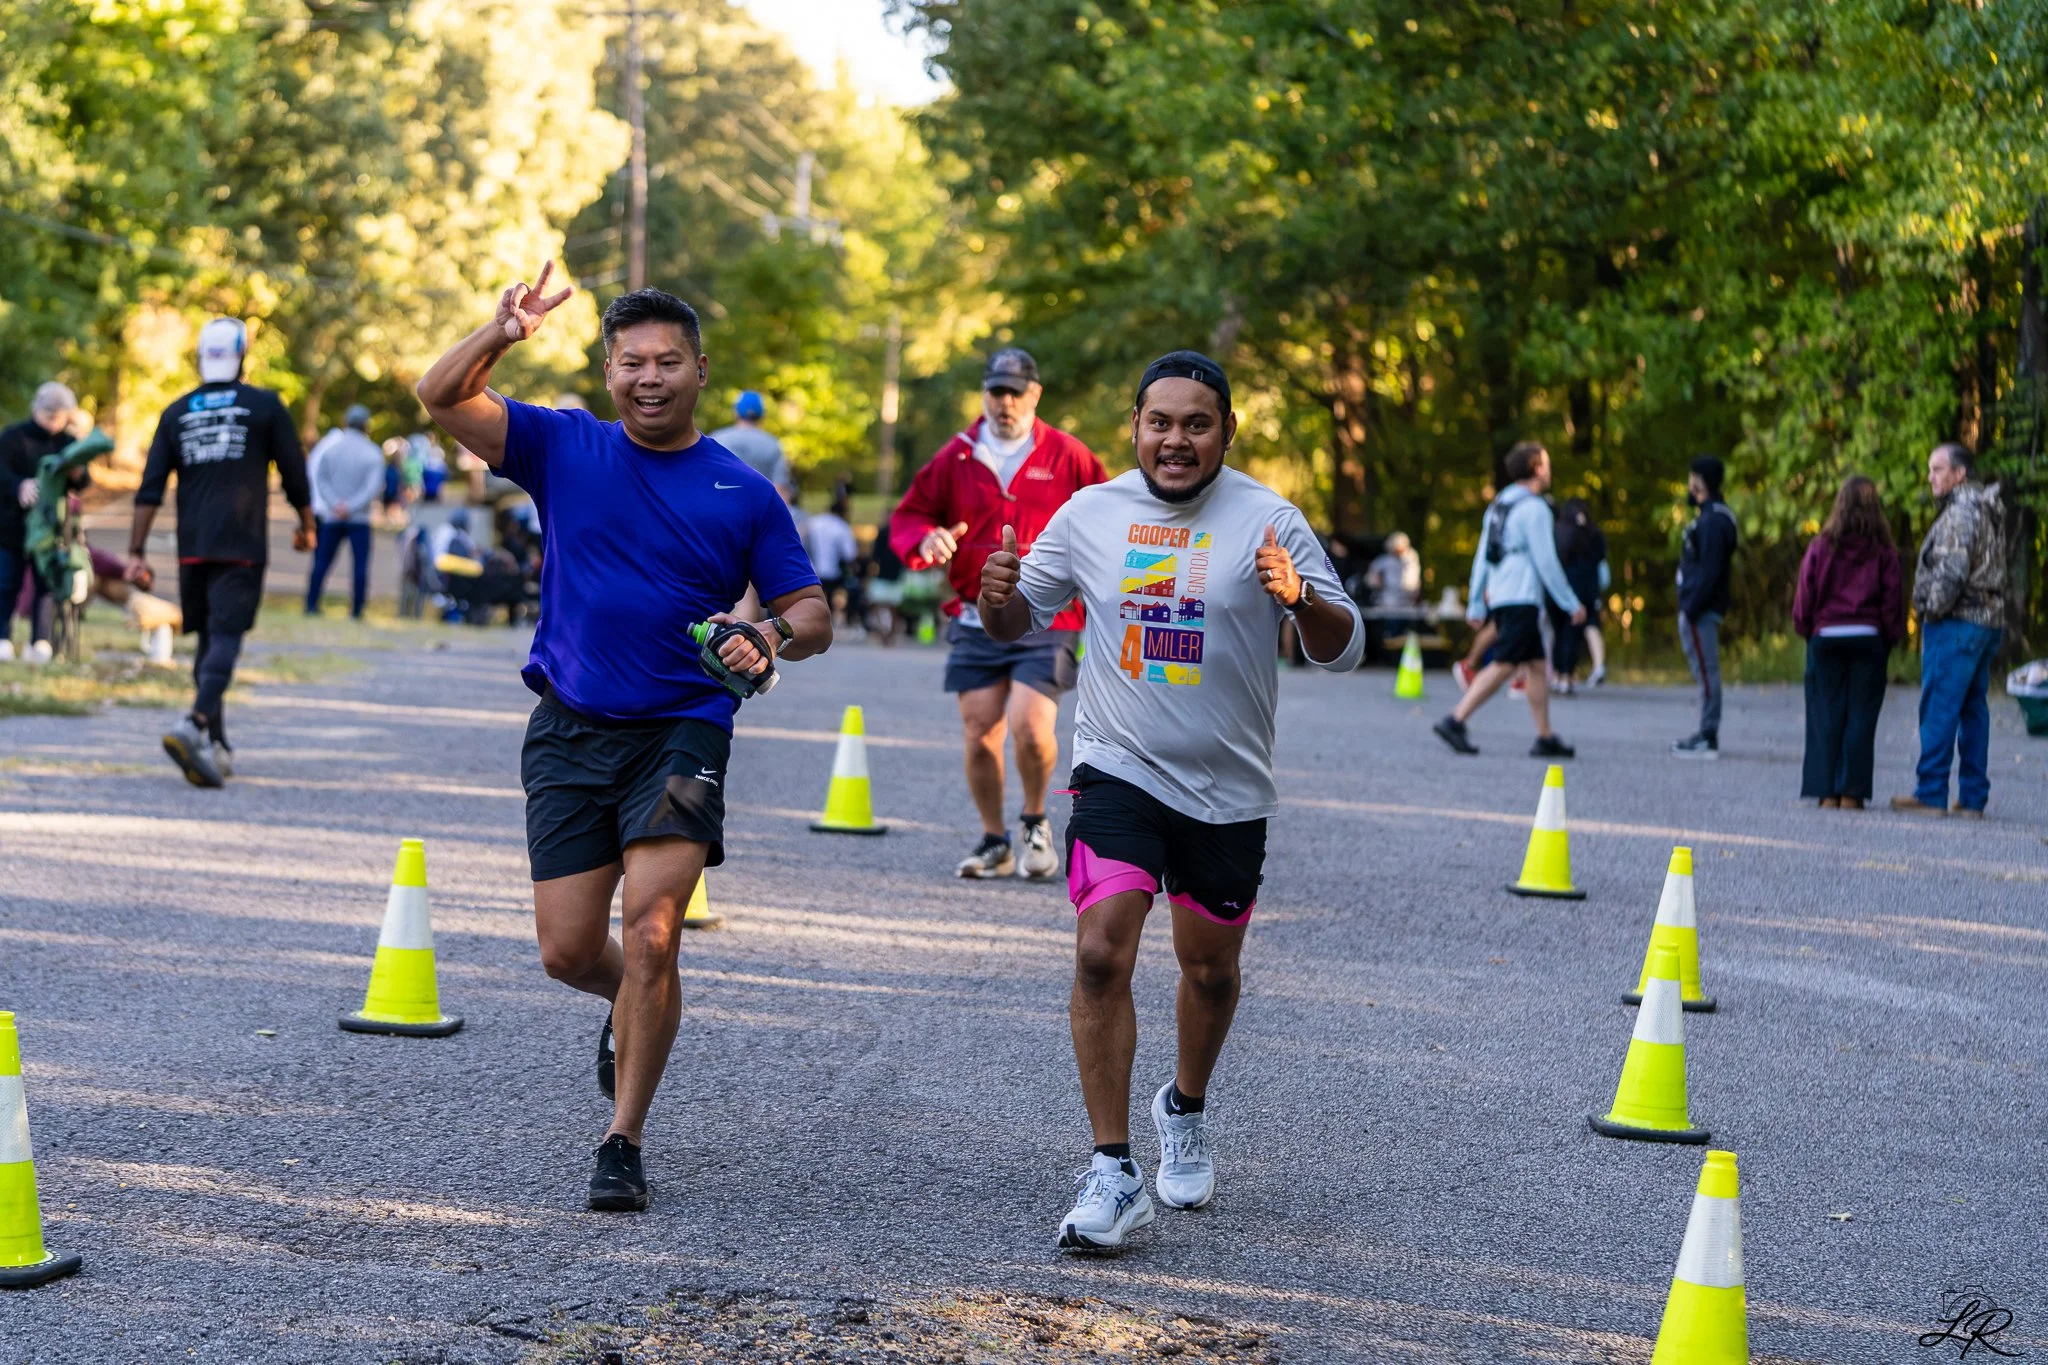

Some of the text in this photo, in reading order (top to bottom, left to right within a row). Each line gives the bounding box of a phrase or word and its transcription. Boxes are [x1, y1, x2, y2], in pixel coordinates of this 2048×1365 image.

[1127, 523, 1191, 549] COOPER
[1187, 551, 1209, 594] YOUNG
[1120, 624, 1201, 680] 4 MILER
[695, 774, 710, 782] NIKE
